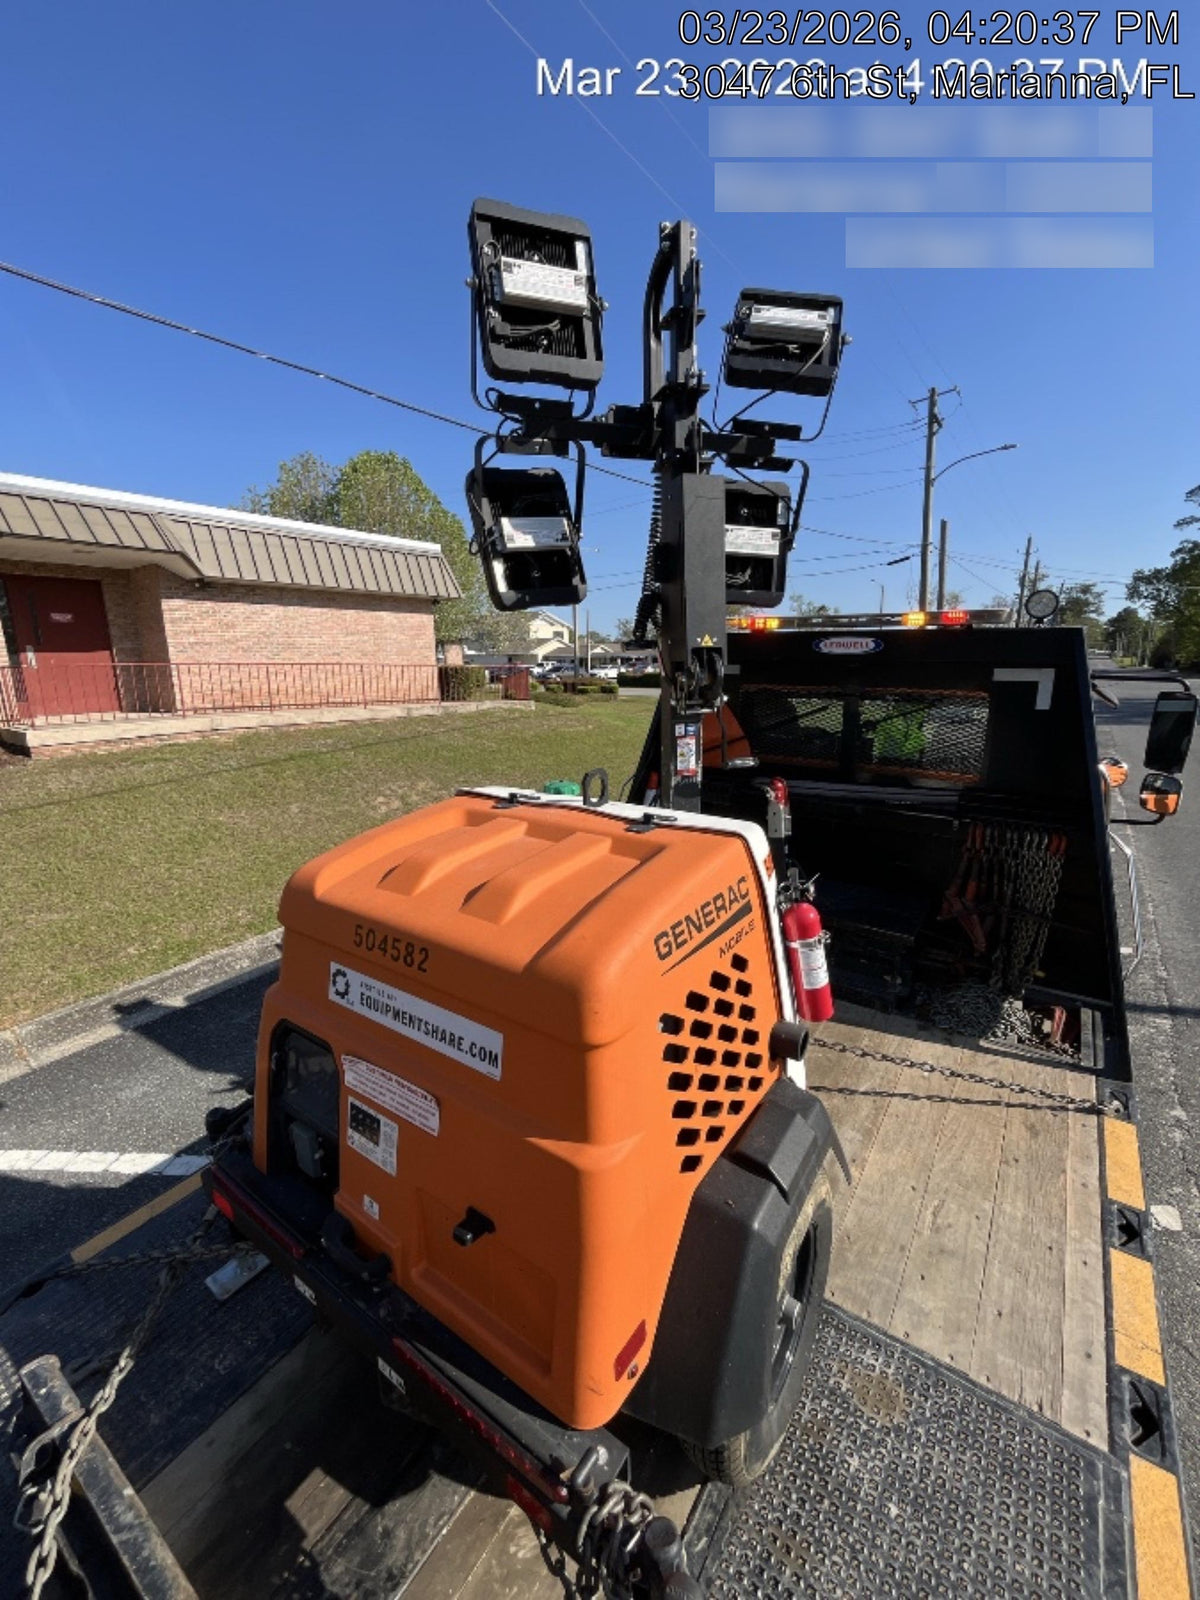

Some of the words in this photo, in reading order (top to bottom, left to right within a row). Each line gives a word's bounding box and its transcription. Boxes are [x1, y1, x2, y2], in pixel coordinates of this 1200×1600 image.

[353, 924, 429, 973] 504582
[654, 876, 750, 960] GENERAC
[719, 918, 755, 958] MOBILE
[360, 991, 499, 1069] EQUIPMENTSHARE.COM
